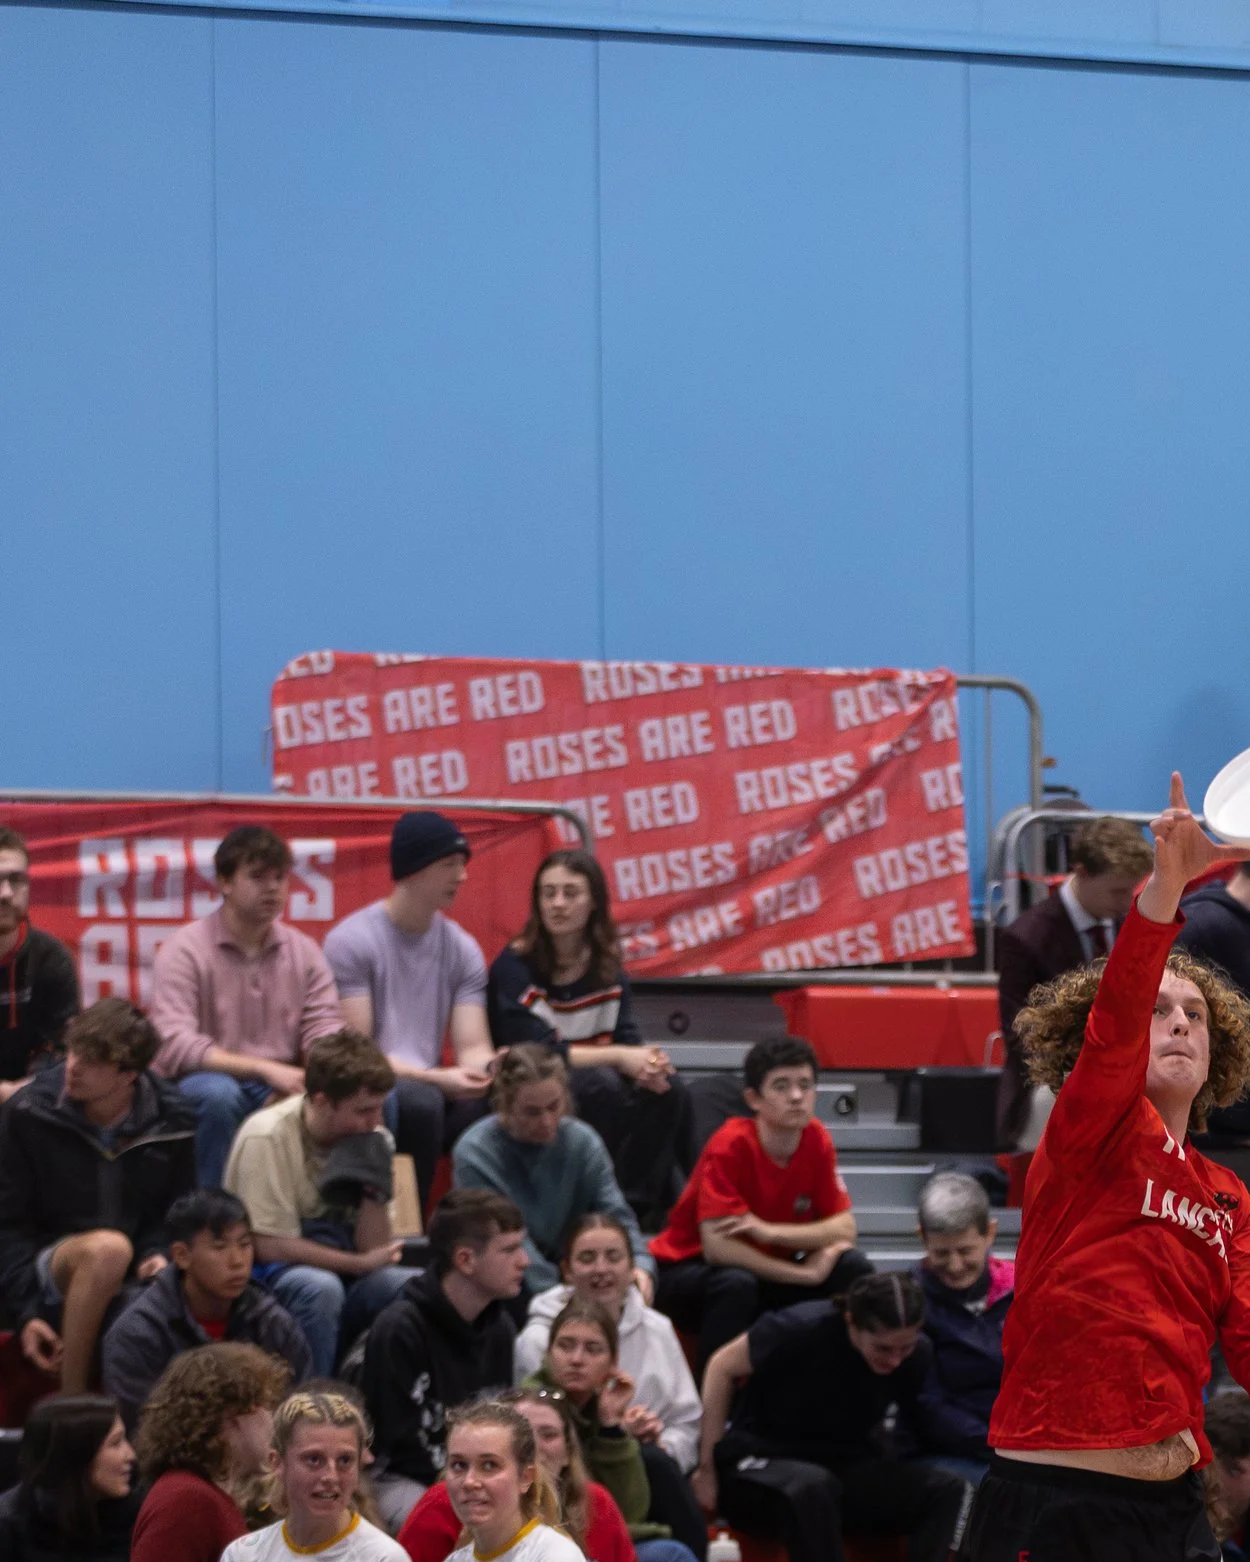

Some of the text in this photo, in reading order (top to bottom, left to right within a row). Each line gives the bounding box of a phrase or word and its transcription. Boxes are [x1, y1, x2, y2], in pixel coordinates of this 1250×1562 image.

[384, 682, 460, 734] ARE
[467, 671, 546, 721] RED
[391, 750, 469, 798] RED
[505, 725, 629, 784] ROSES
[639, 712, 715, 763] ARE
[723, 700, 797, 749] RED
[623, 782, 698, 833] RED
[734, 753, 860, 815] ROSES
[78, 835, 336, 921] ROSS
[613, 842, 738, 901] ROSES
[752, 876, 822, 929] RED
[854, 832, 967, 899] ROSES
[890, 900, 965, 957] ARE
